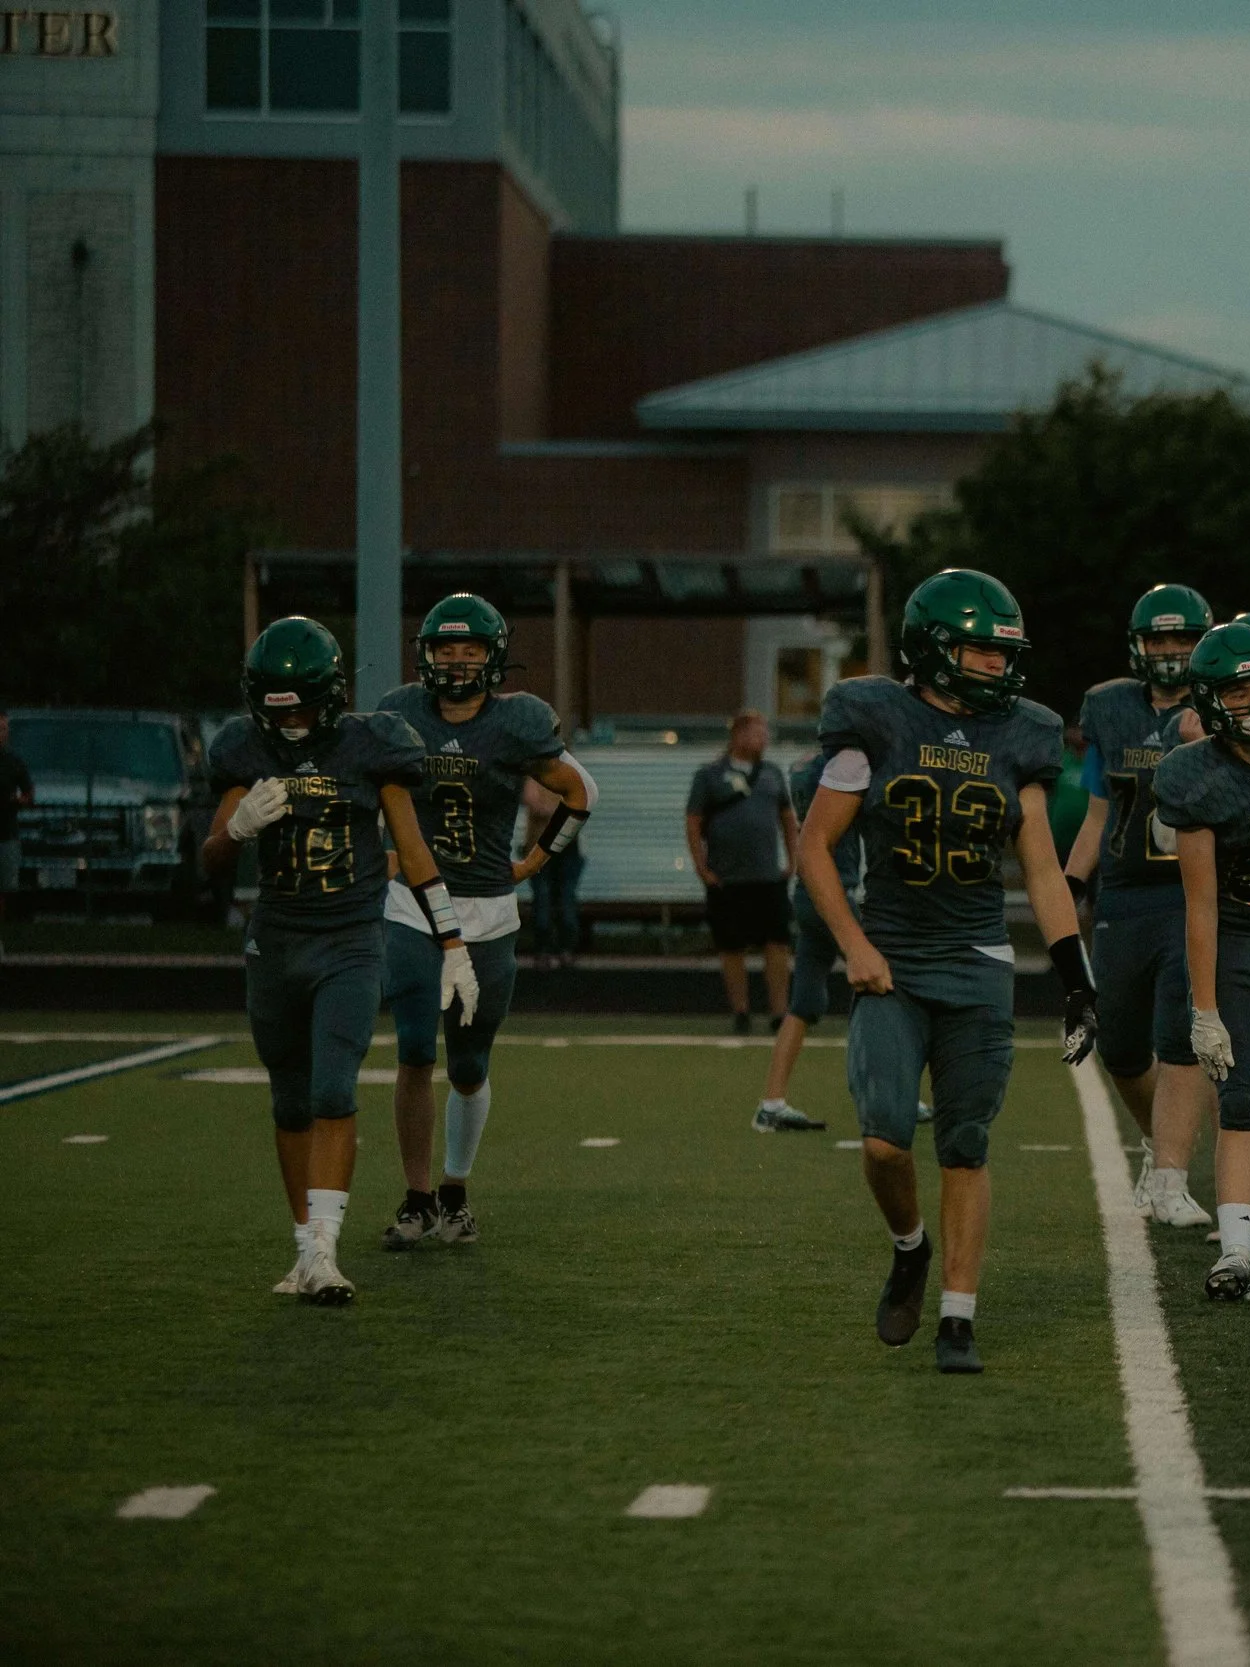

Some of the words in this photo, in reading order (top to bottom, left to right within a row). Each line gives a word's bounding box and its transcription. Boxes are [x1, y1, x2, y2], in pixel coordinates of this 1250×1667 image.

[0, 11, 117, 57] TER
[424, 756, 479, 777] IRISH
[920, 744, 990, 777] IRISH
[1123, 748, 1164, 770] IRIS
[885, 774, 1007, 887] 33
